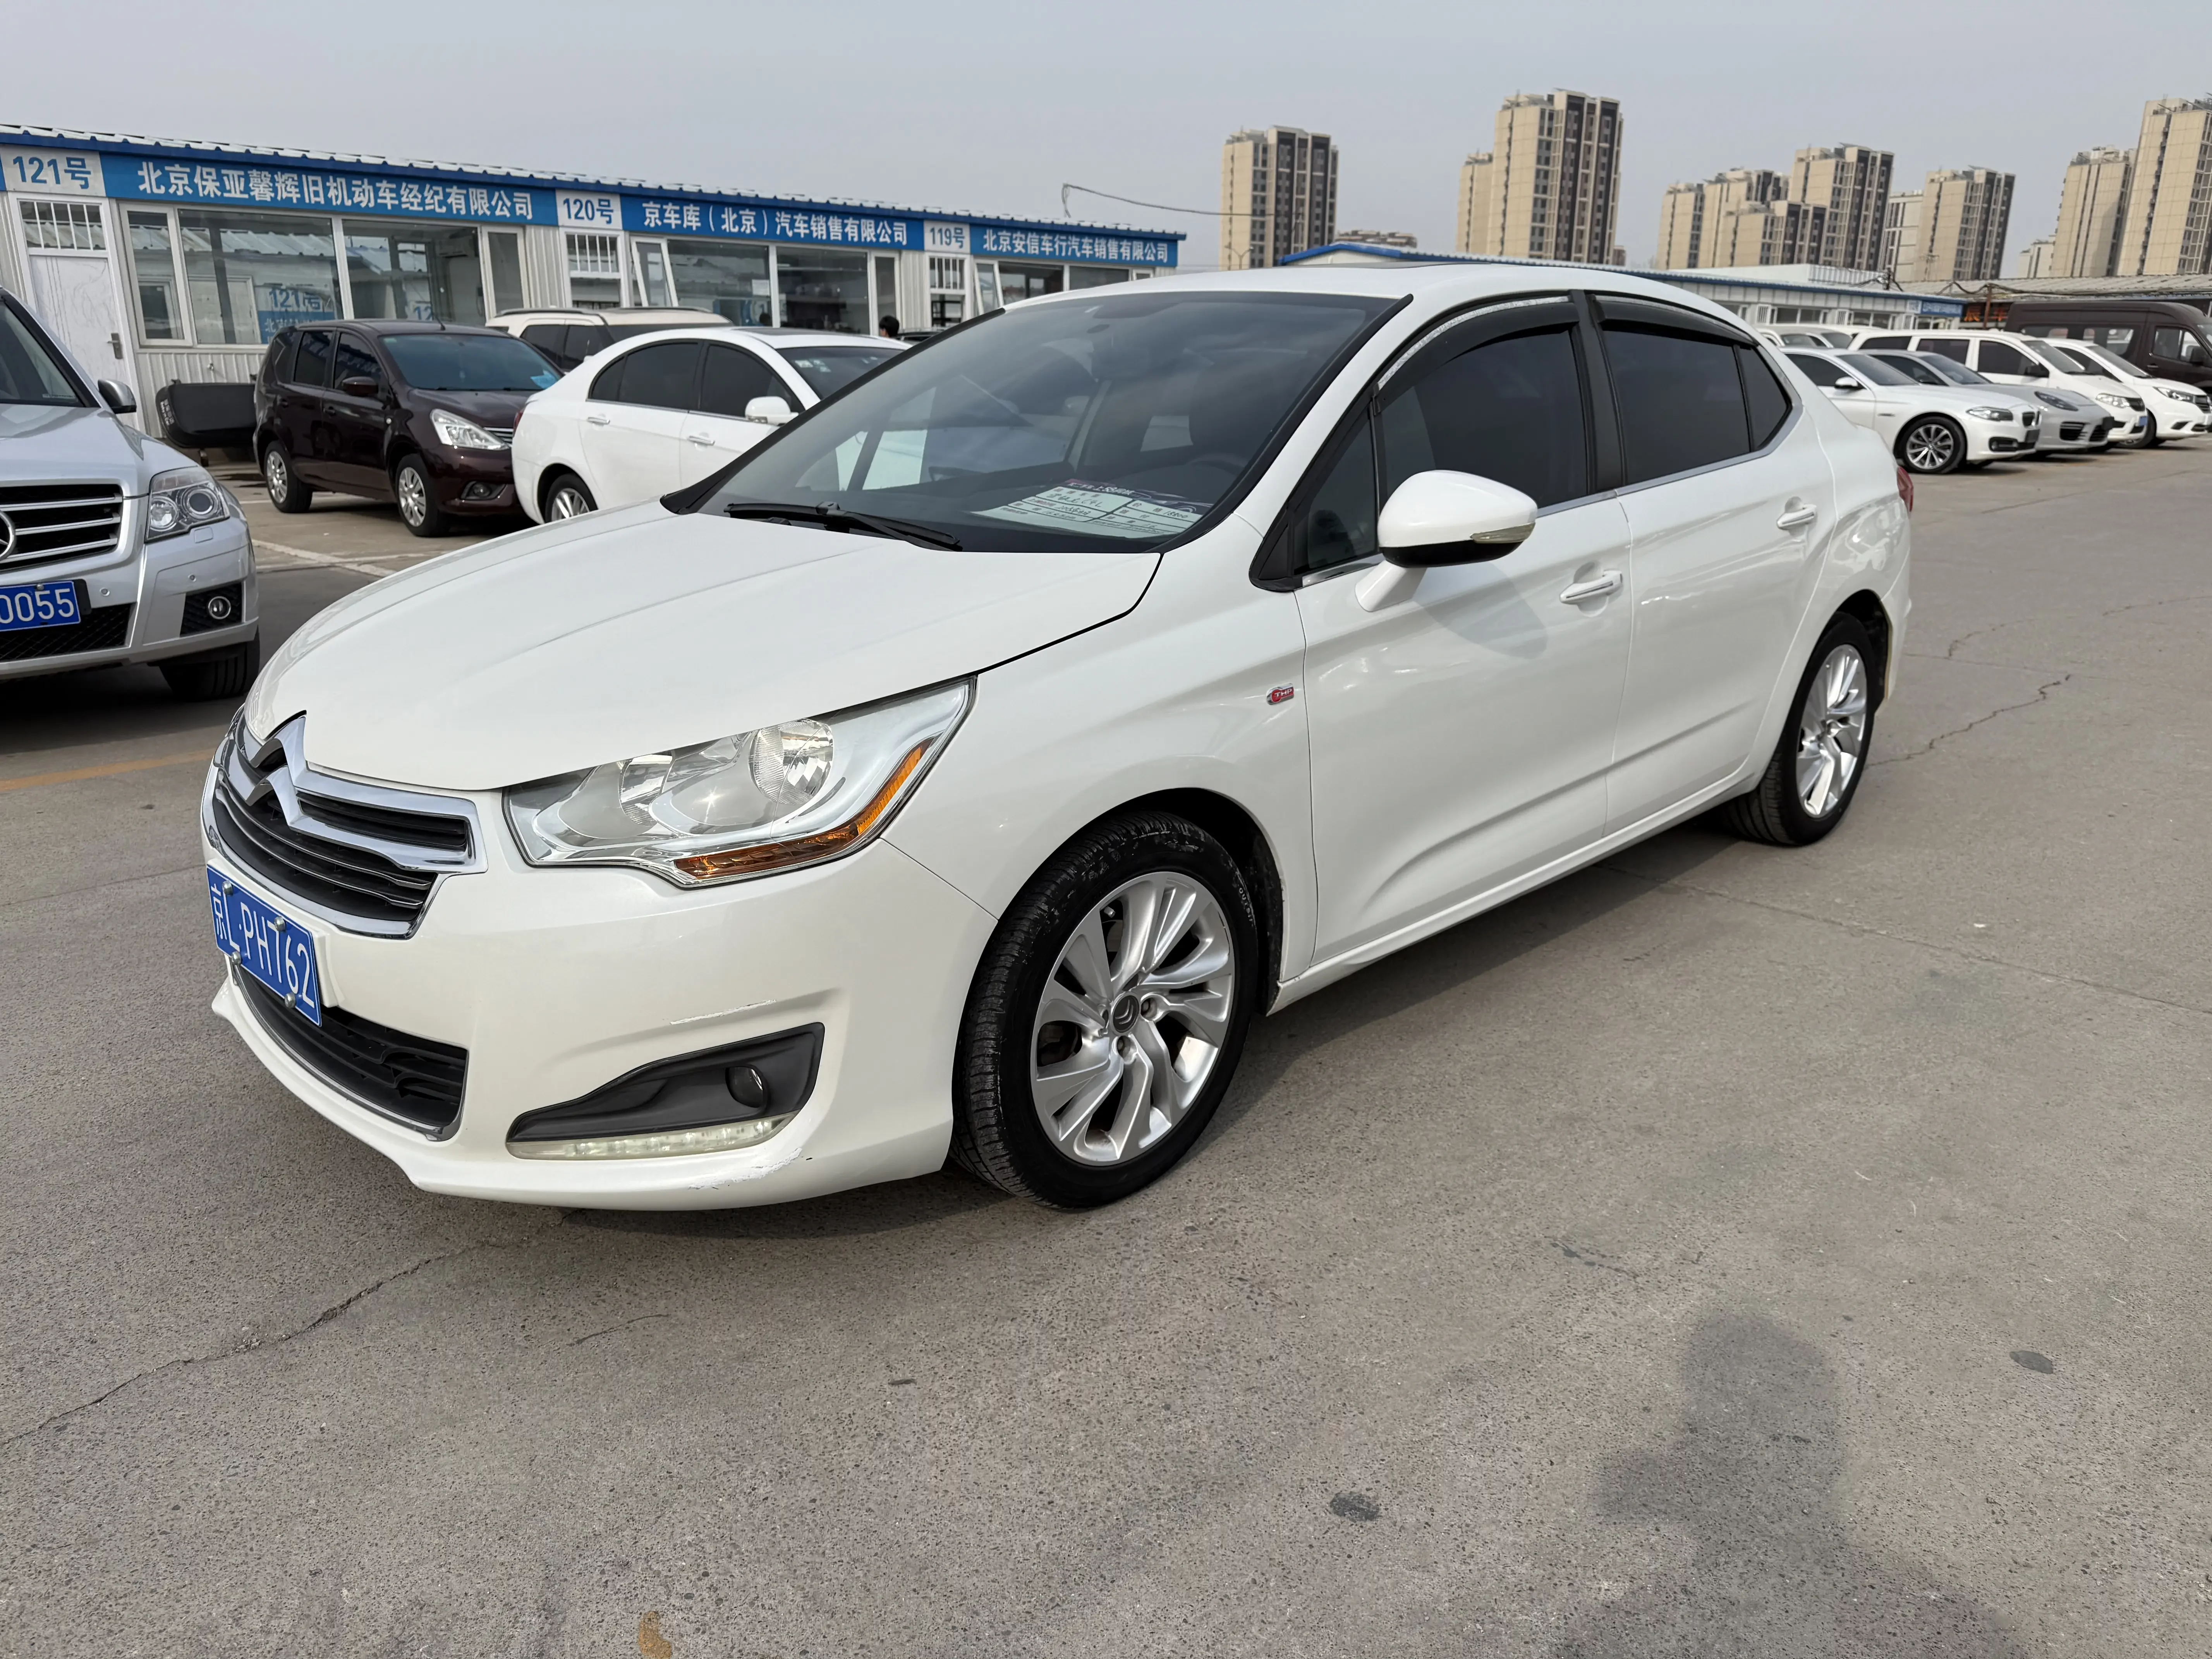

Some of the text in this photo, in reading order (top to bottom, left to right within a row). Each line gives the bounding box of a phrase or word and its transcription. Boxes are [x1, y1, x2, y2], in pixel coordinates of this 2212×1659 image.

[13, 156, 91, 189] 121号
[137, 161, 532, 220] 北京保亚馨辉旧机动车经纪有限公司
[563, 198, 613, 224] 120号
[930, 227, 965, 249] 119号
[983, 229, 1168, 263] 北京安信车行汽车销售有限公司
[0, 588, 74, 624] 0055
[1274, 689, 1292, 697] THP
